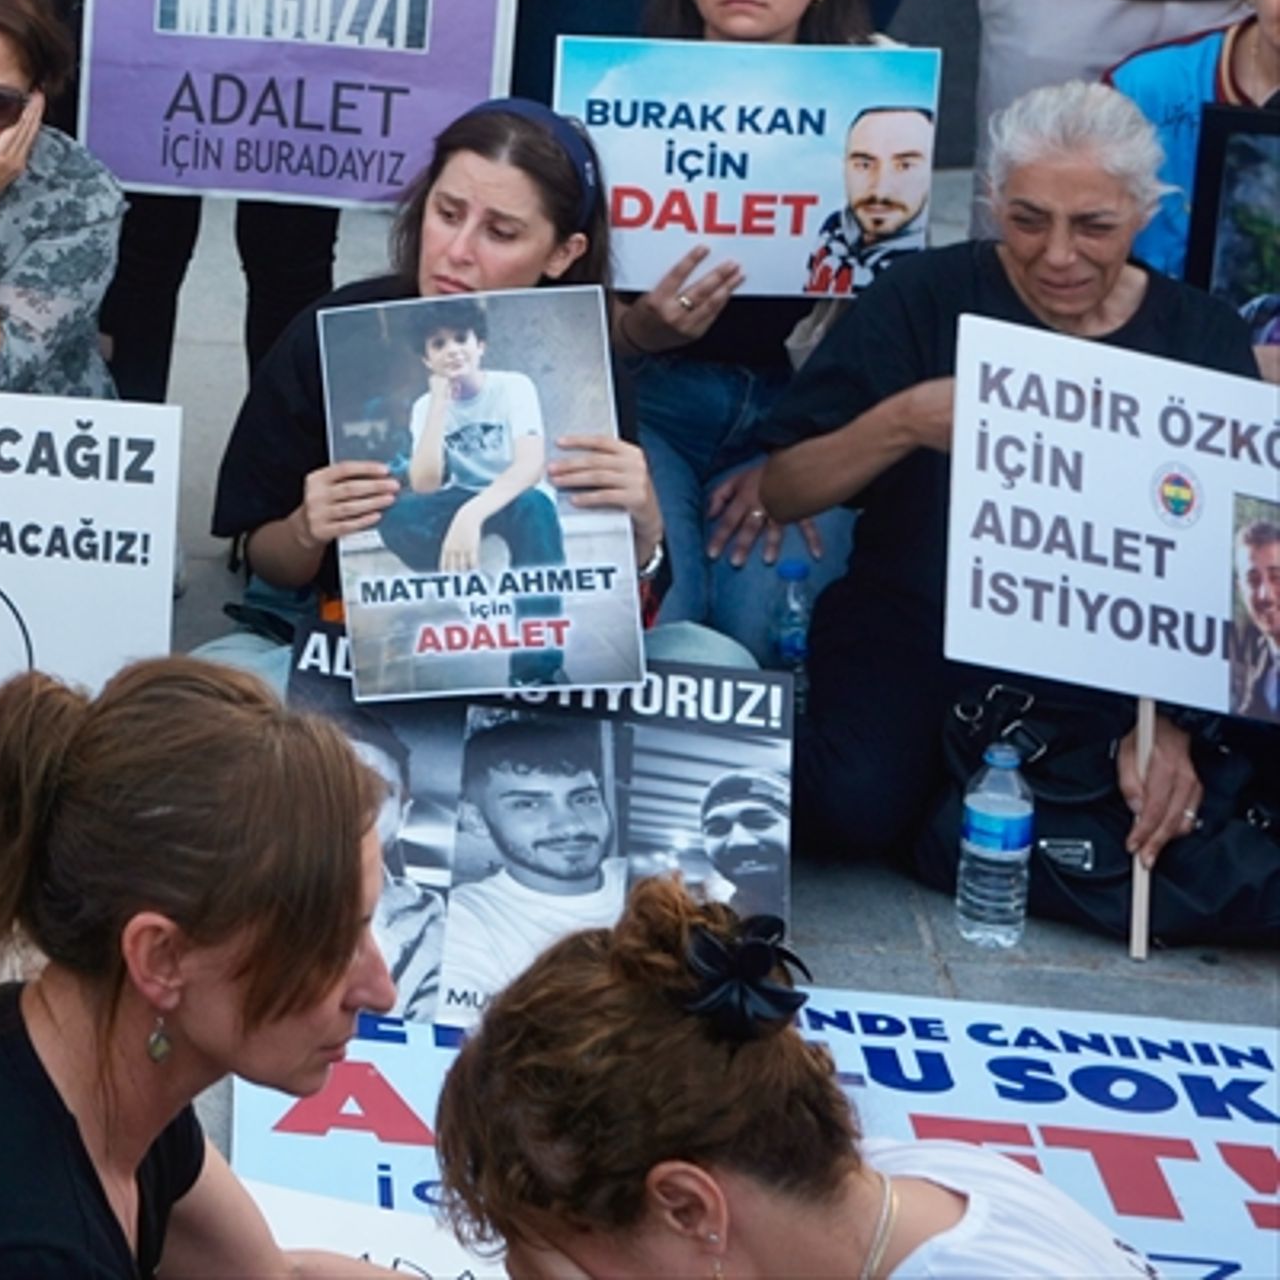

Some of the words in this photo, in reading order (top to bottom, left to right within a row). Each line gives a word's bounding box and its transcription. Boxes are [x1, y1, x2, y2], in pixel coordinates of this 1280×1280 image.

[162, 72, 410, 138] ADALET
[585, 98, 727, 132] BURAK
[737, 106, 827, 137] KAN
[160, 127, 222, 171] İÇİN
[235, 138, 405, 187] BURADAYIZ
[664, 139, 749, 183] İÇİN
[610, 185, 819, 238] DALET
[977, 361, 1142, 438] KADİR
[975, 420, 1085, 493] İÇİN
[970, 499, 1177, 579] ADALET
[360, 573, 489, 604] MATTIA
[498, 566, 618, 594] AHMET
[469, 602, 512, 619] için
[416, 621, 571, 654] ADALET
[966, 1022, 1275, 1072] CANININ
